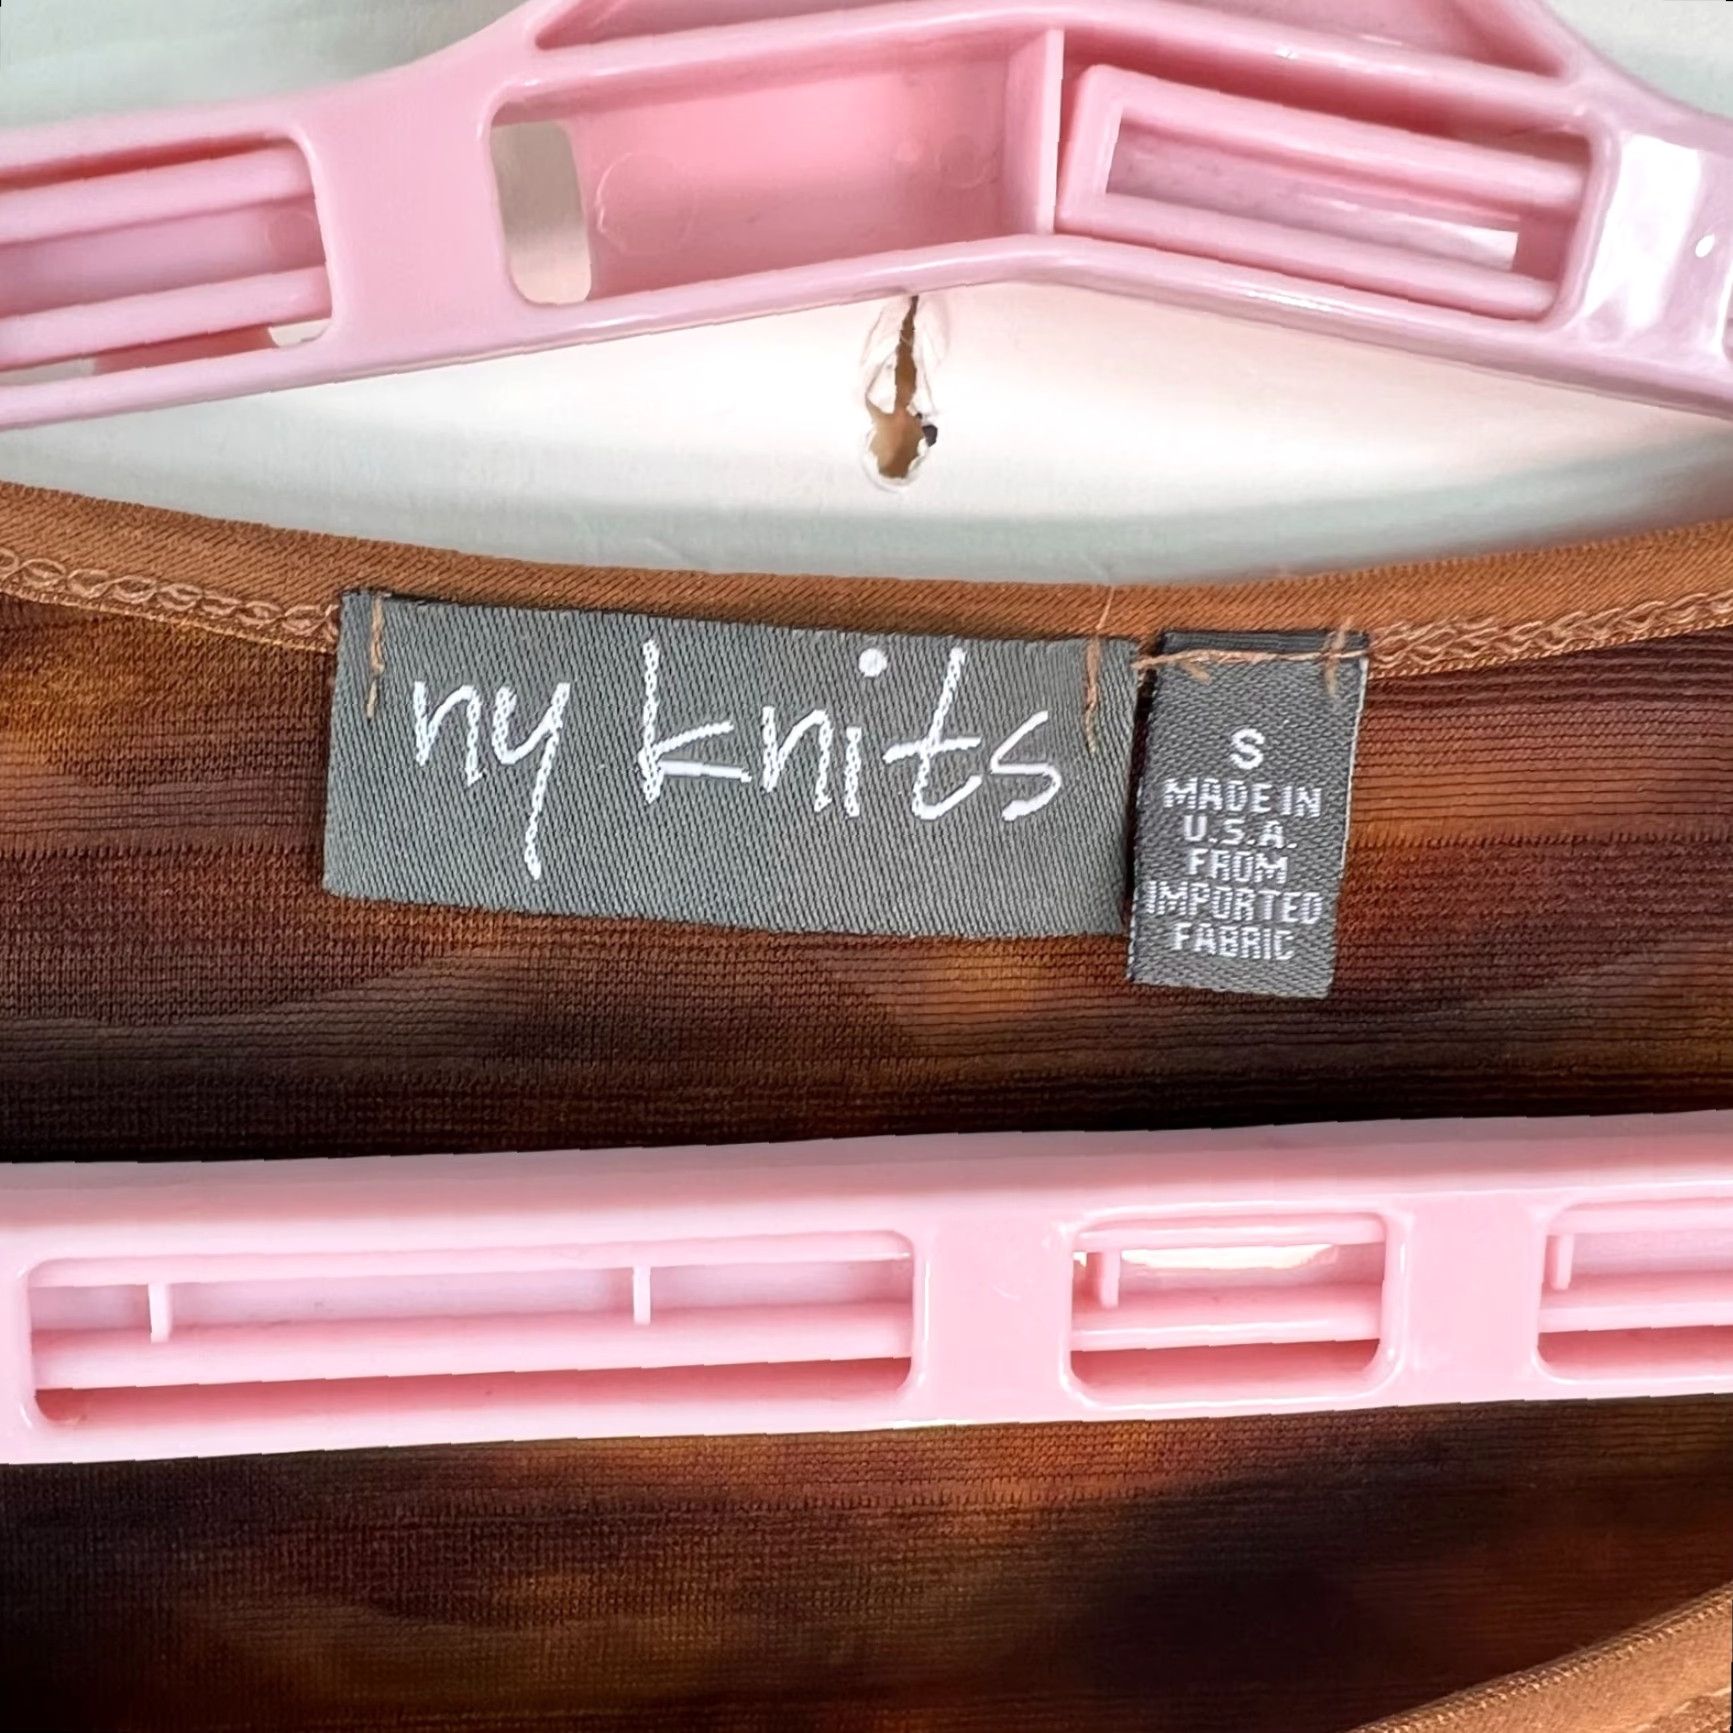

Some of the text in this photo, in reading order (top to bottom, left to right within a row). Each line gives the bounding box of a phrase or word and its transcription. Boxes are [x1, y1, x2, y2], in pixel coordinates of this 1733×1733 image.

[413, 638, 1063, 880] ny knits
[1230, 728, 1266, 770] S
[1163, 777, 1322, 818] MADE IN
[1183, 814, 1298, 849] U.S.A.
[1187, 848, 1288, 884] FROM
[1145, 880, 1323, 925] IMPORTED
[1172, 921, 1296, 960] FABRIC
